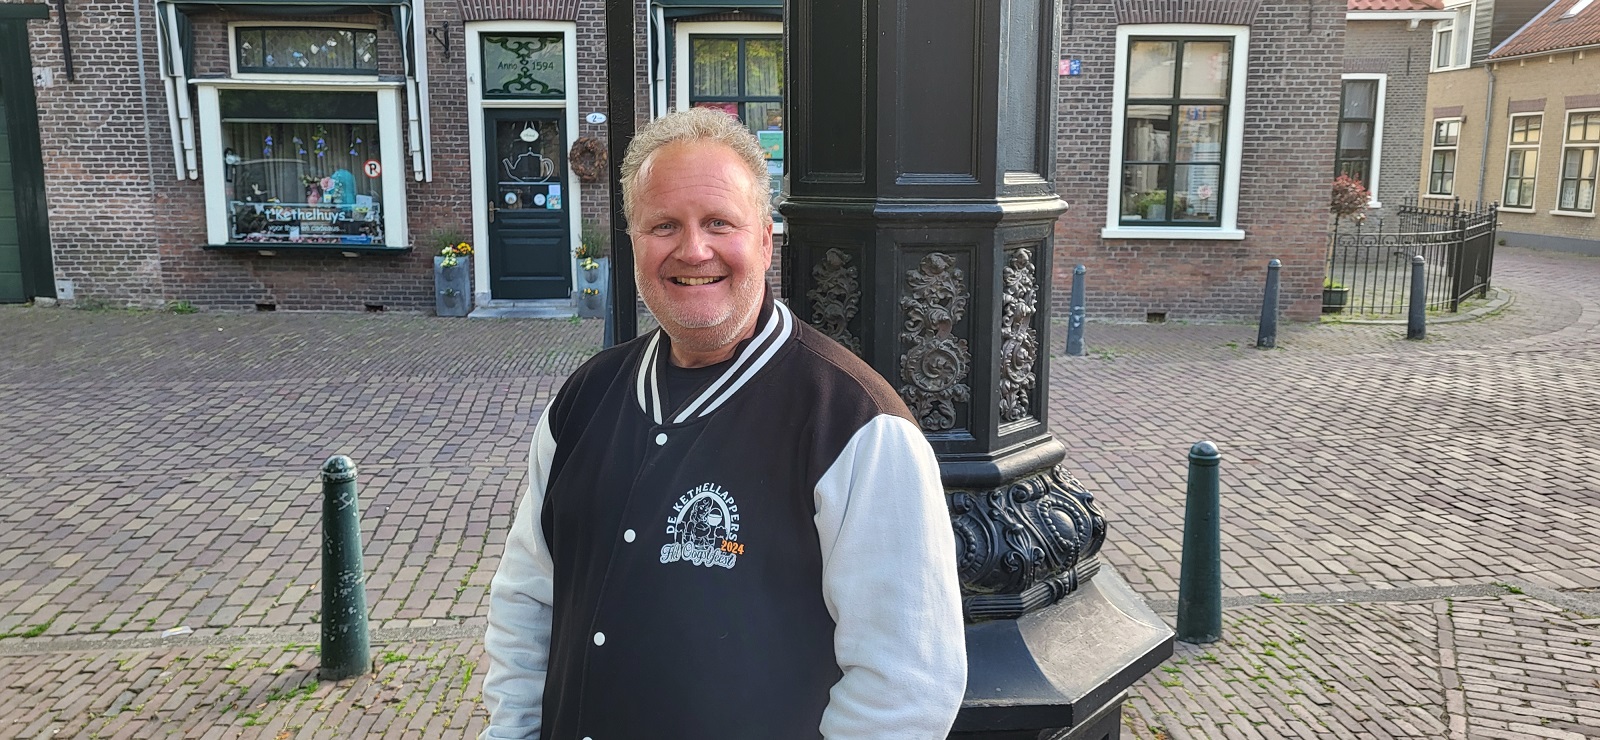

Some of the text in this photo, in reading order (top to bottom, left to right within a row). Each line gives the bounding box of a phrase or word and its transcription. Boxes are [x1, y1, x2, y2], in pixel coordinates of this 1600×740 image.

[497, 61, 554, 71] Anno 1594
[591, 114, 598, 123] 2
[666, 482, 740, 542] DE KETHELLAPPERS
[721, 540, 745, 555] 2024
